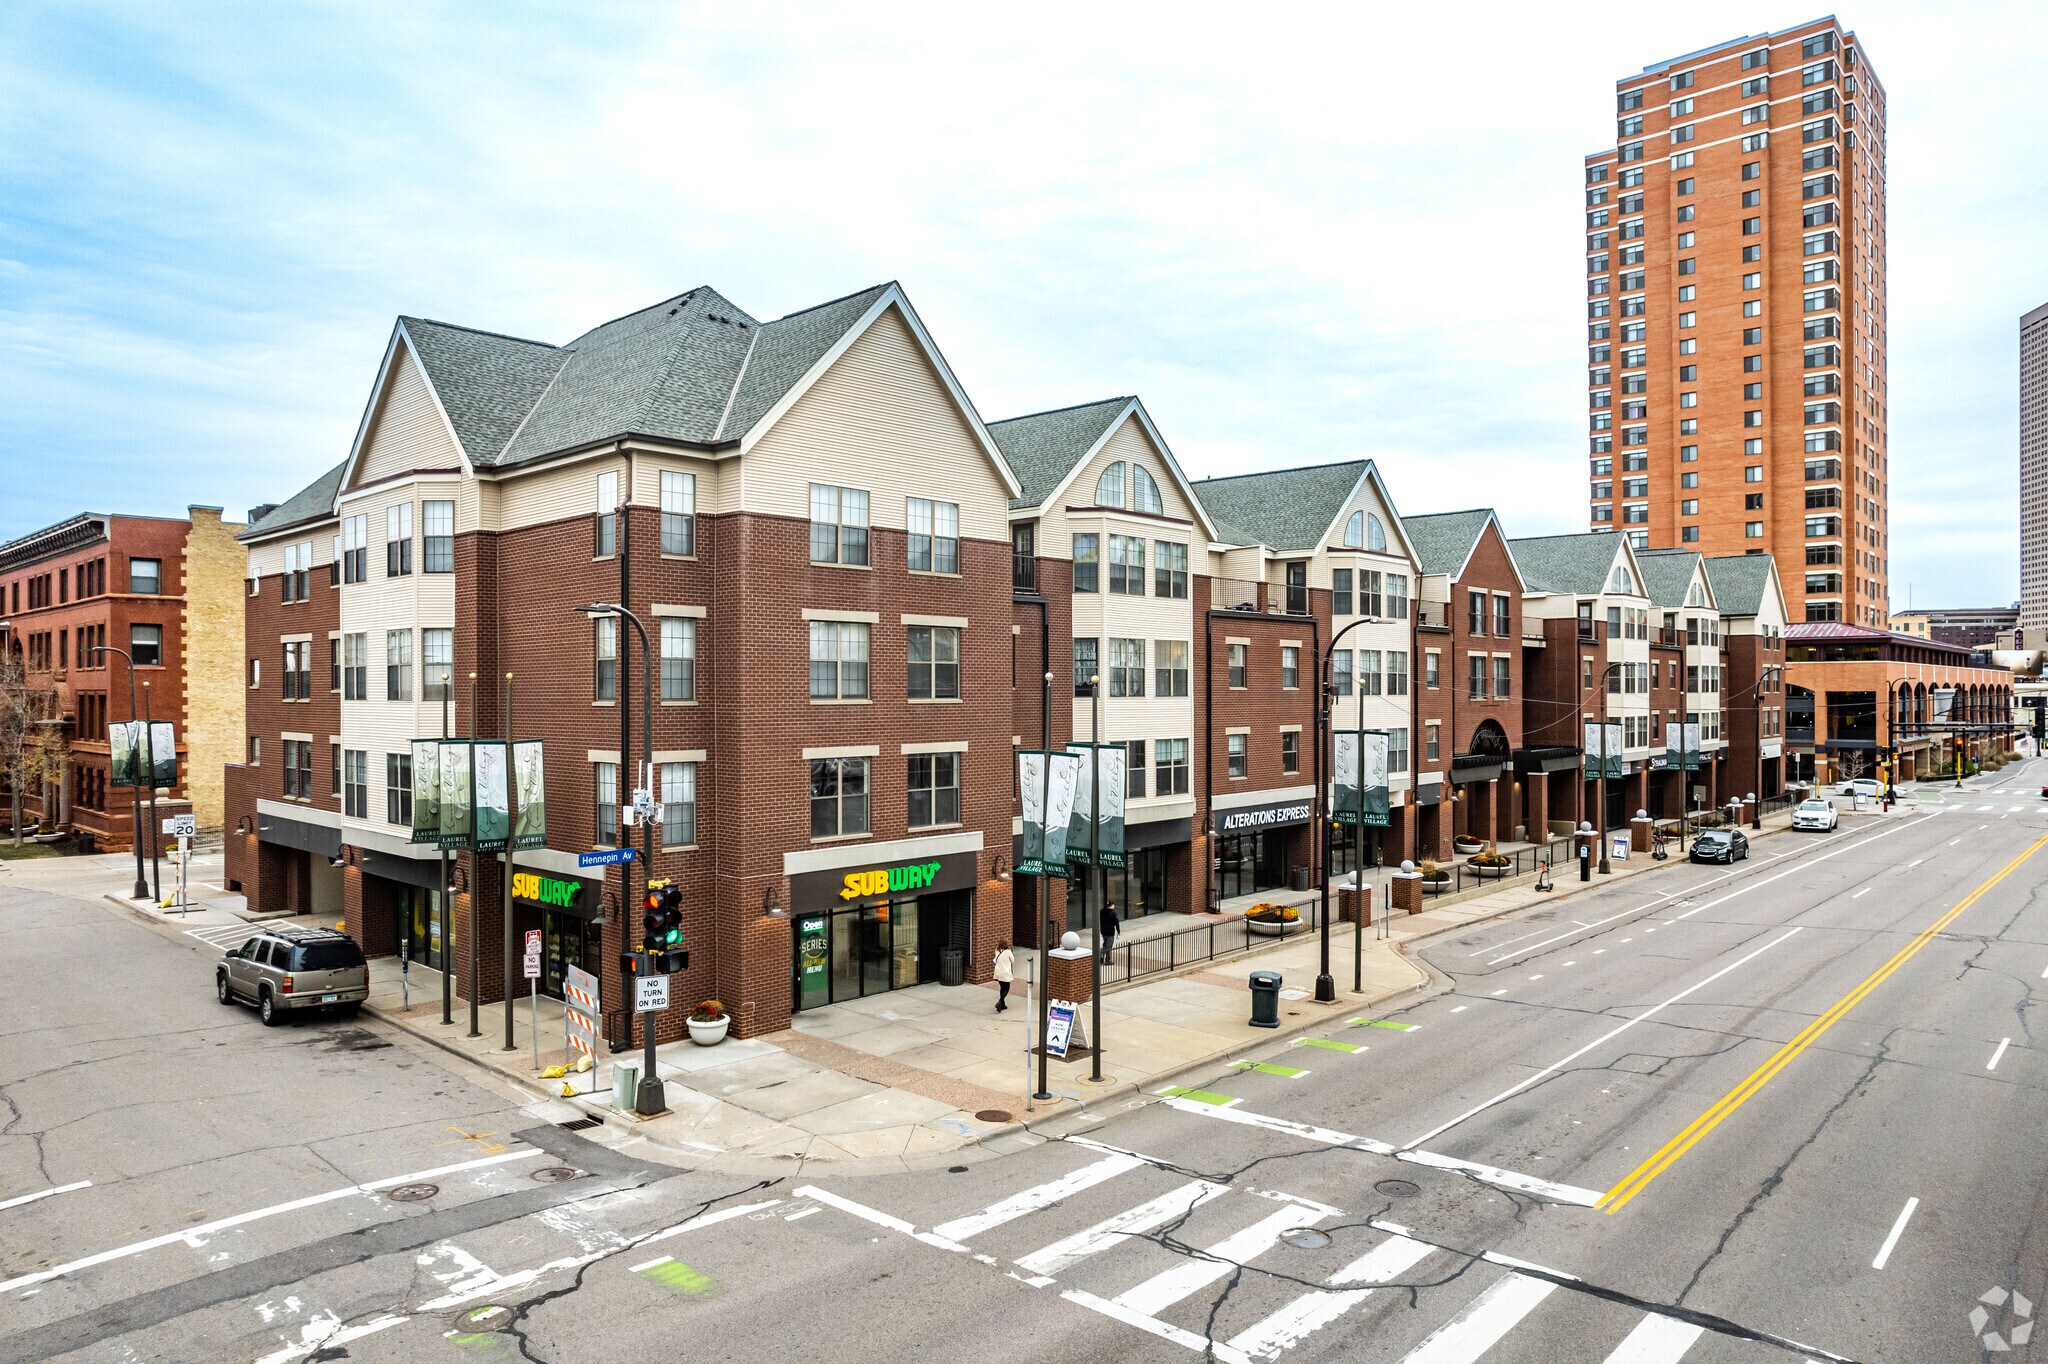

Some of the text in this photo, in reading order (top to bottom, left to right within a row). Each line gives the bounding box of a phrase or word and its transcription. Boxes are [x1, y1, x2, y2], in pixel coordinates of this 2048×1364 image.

[1224, 805, 1310, 829] ALTERATIONS EXPRESS
[176, 826, 194, 835] 20
[517, 836, 543, 844] LAUREL
[480, 841, 505, 849] LAUREL
[1065, 848, 1090, 858] LAUREL
[1099, 853, 1123, 862] LAUREL
[582, 851, 633, 865] Hennepin Av
[1023, 859, 1043, 867] LAURE
[1099, 859, 1125, 868] VILLAGE
[1044, 864, 1066, 873] LAUREL
[839, 860, 942, 901] SUBWAY
[512, 873, 581, 908] SUBWAY
[803, 920, 824, 930] Open
[801, 939, 828, 954] SERIES
[807, 964, 823, 974] MENU
[647, 979, 659, 987] NO
[643, 989, 663, 997] TURN
[652, 997, 666, 1007] RED
